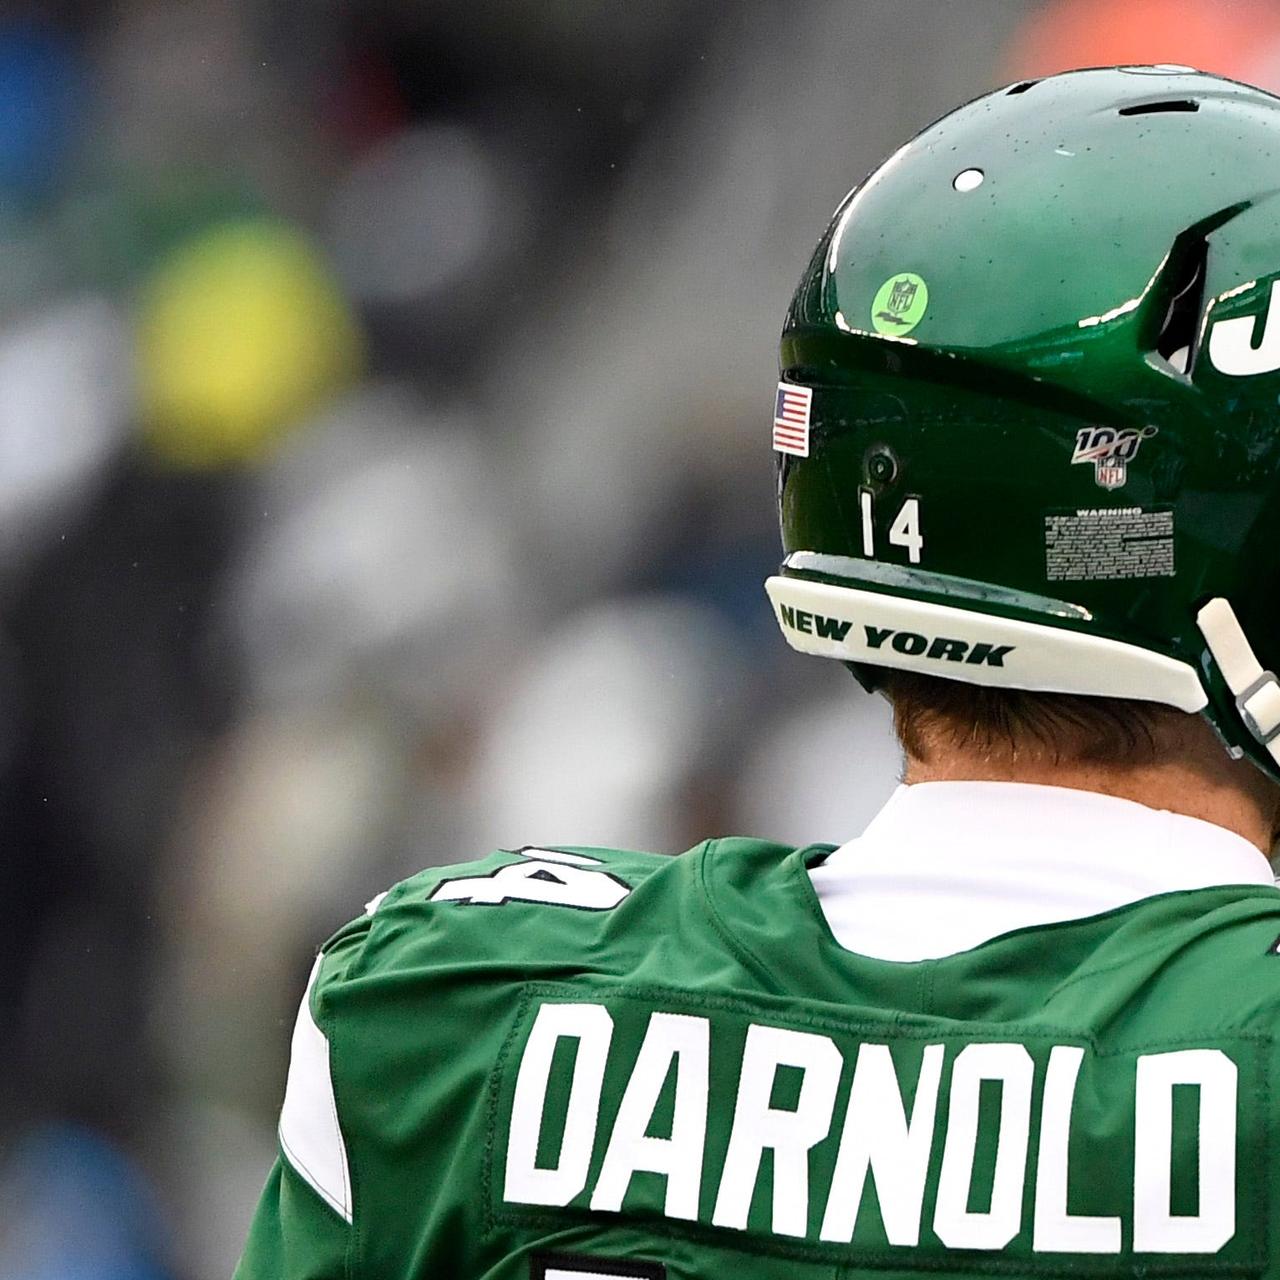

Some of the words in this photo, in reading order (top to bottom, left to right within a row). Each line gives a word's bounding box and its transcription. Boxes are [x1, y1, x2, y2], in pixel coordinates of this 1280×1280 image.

[1098, 465, 1123, 484] NFL
[861, 490, 924, 564] 14
[1076, 507, 1142, 517] WARNING
[780, 603, 853, 642] NEW
[863, 624, 1017, 667] YORK
[503, 1002, 1238, 1255] DARNOLD
